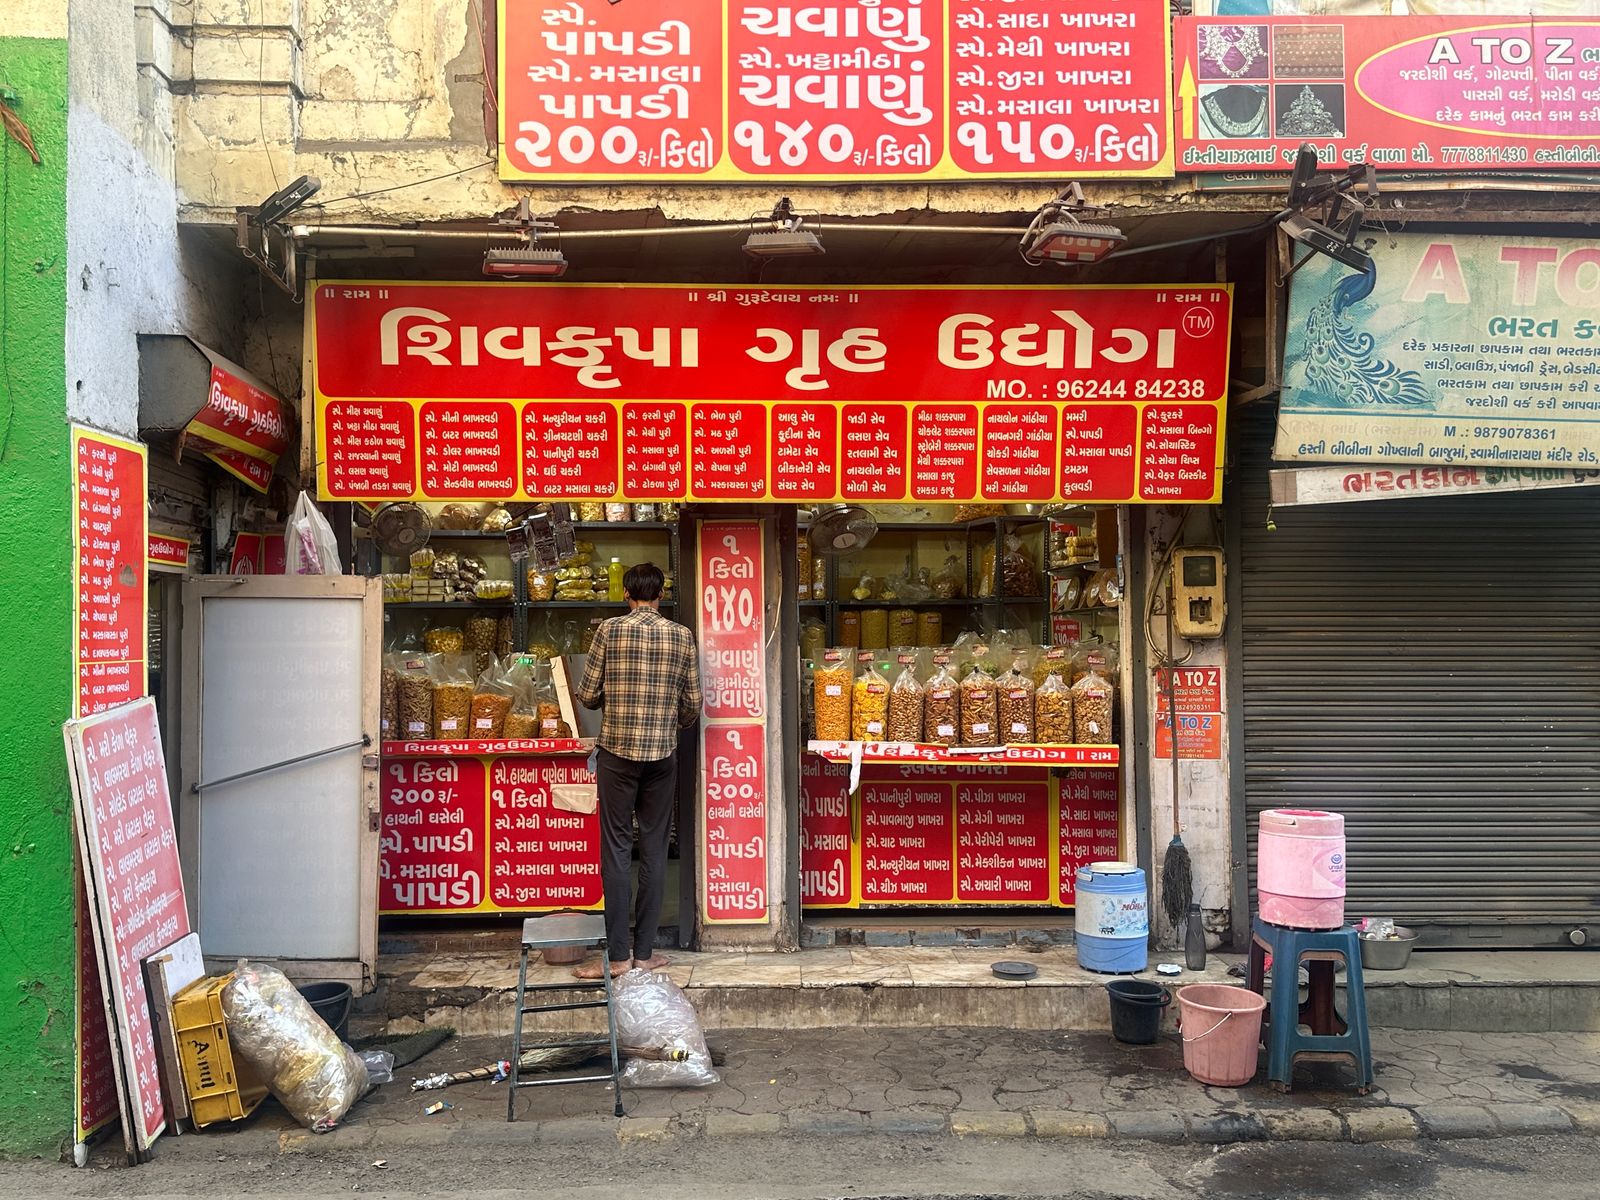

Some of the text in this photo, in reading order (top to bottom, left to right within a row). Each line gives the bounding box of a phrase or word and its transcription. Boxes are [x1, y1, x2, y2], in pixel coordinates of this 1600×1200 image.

[1061, 13, 1135, 27] ખાખરા
[541, 20, 692, 56] પાપડી
[1055, 42, 1129, 56] ખાખરા
[1427, 37, 1575, 65] A TO Z
[1056, 71, 1131, 85] ખાખરા
[739, 60, 934, 125] ચવાણું
[539, 83, 689, 120] પાપડી
[1084, 99, 1159, 113] ખાખરા
[1436, 107, 1463, 121] દરેક
[1470, 110, 1506, 125] કામનું
[1511, 111, 1542, 121] ભરત
[1548, 111, 1572, 121] કામ
[1441, 145, 1528, 163] 7778811430
[1401, 242, 1471, 305] A
[343, 290, 370, 298] રામ
[1175, 294, 1201, 302] રામ
[1187, 315, 1211, 330] TM
[1489, 317, 1558, 337] ભરત
[379, 306, 700, 390] શિવકૃપા
[745, 326, 887, 391] ગૃહ
[1403, 339, 1551, 356] દરેક પ્રકારના છાપકામ તથા
[986, 379, 1205, 399] MO. 96244 84238
[1437, 379, 1588, 392] ભરતકામ તથા છાપકામ કરી
[1466, 395, 1556, 409] જરદોશી વર્ક કરી
[442, 411, 459, 422] મીની
[463, 412, 497, 423] ભાખરવડી
[585, 411, 606, 423] ચકરી
[729, 410, 741, 423] પુરી
[778, 410, 814, 425] આલુ સેવ
[871, 412, 884, 424] સેવ
[1067, 410, 1087, 421] મમરી
[442, 431, 459, 439] બટર
[463, 428, 497, 439] ભાખરવડી
[1444, 426, 1456, 437] M
[1474, 427, 1556, 440] 9879078361
[667, 444, 679, 457] પુરી
[847, 446, 897, 458] રતલામી સેવ
[1298, 440, 1326, 456] હસ્તી
[1331, 441, 1372, 455] બીબીના
[1065, 465, 1088, 474] ટમટમ
[544, 485, 561, 493] બટર
[566, 485, 590, 493] મસાલા
[595, 482, 615, 493] ચકરી
[709, 556, 754, 579] કિલો
[1185, 671, 1204, 687] TO
[1207, 670, 1217, 687] Z
[413, 760, 459, 783] કિલો
[713, 756, 758, 778] કિલો
[390, 789, 435, 805] ૨૦૦
[511, 787, 547, 808] કિલો
[998, 793, 1025, 803] ખાખરા
[384, 807, 464, 826] હાથની ઘસેલી
[546, 817, 585, 829] ખાખરા
[997, 815, 1024, 824] ખાખરા
[412, 827, 474, 852] પાપડી
[899, 838, 925, 847] ખાખરા
[709, 836, 764, 859] પાપડી
[400, 863, 459, 879] મસાલા
[560, 862, 599, 876] ખાખરા
[392, 870, 480, 906] પાપડી
[709, 882, 750, 892] મસાલા
[901, 883, 926, 893] ખાખરા
[1005, 880, 1031, 891] ખાખરા
[709, 888, 764, 910] પાપડી
